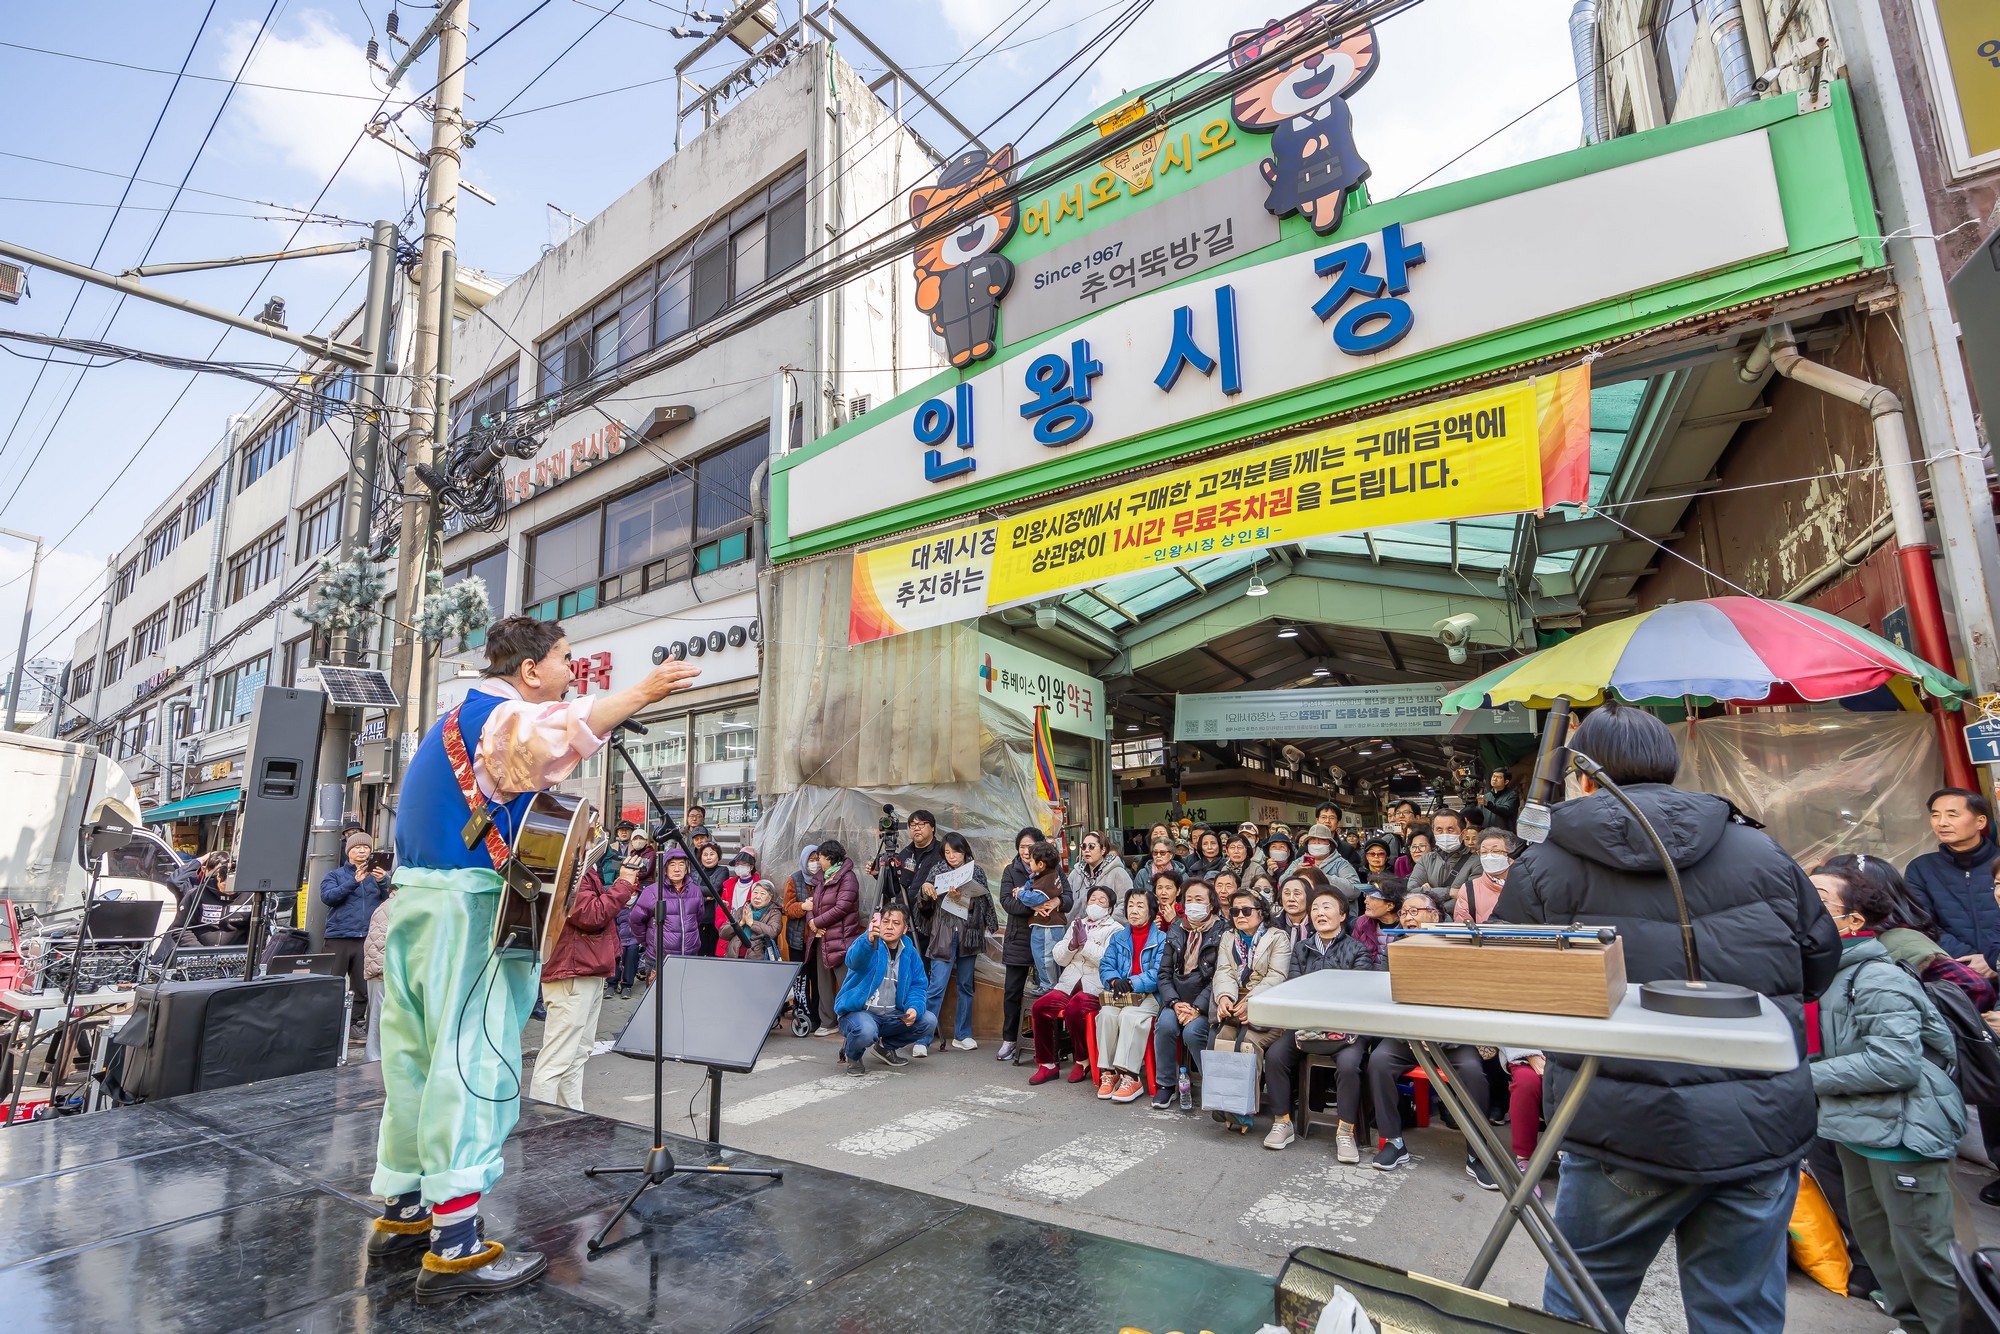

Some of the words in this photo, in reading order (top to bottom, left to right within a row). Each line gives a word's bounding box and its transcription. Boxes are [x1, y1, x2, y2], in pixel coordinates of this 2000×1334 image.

[1022, 119, 1236, 236] 어서오시오
[913, 223, 1427, 484] 인왕시장
[535, 448, 571, 487] 자재
[571, 418, 629, 472] 전시장
[665, 409, 677, 419] 2F
[1012, 499, 1123, 550] 인왕시장에서
[1126, 481, 1191, 517] 구매한
[1196, 445, 1345, 499] 고객분들께는
[1354, 407, 1506, 462] 구매금액에
[1031, 533, 1106, 573] 상관없이
[1113, 520, 1165, 552] 1시간
[1330, 458, 1459, 505] 드립니다.
[896, 566, 984, 609] 추진하는
[1001, 669, 1036, 696] 휴베이스
